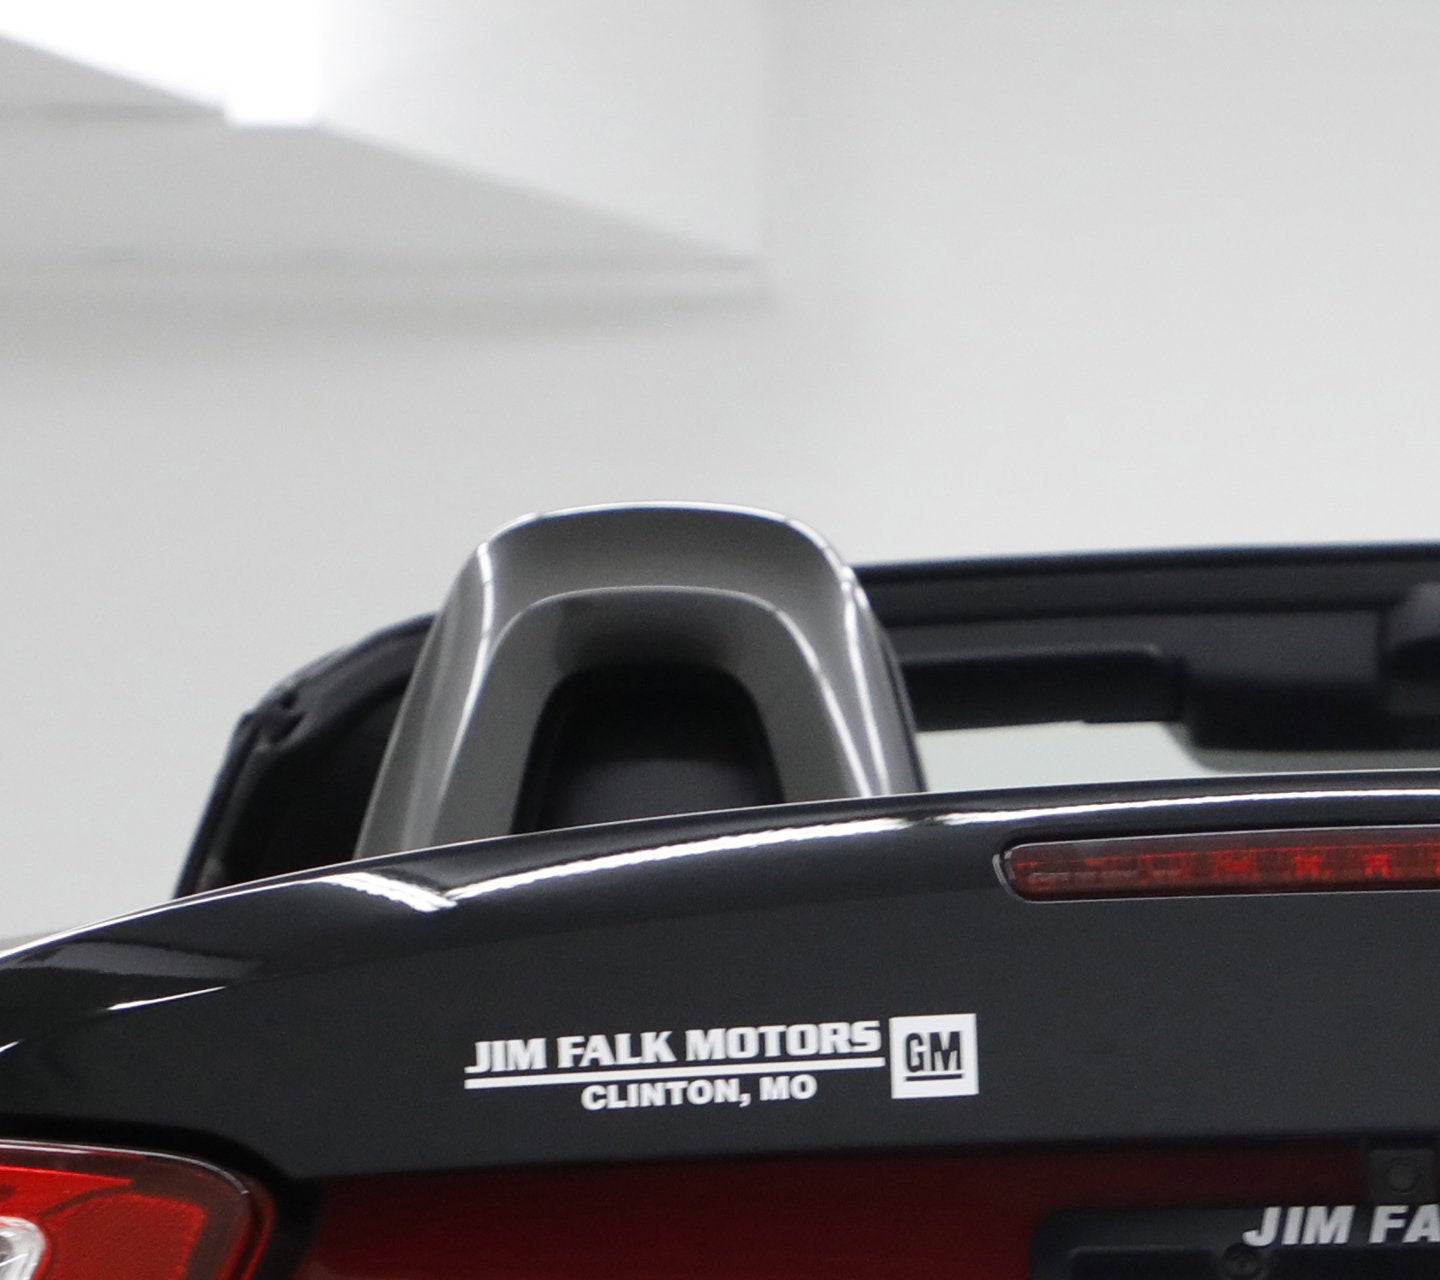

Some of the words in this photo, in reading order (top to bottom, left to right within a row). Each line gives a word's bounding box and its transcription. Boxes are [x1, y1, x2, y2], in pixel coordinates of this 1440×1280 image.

[464, 1037, 548, 1074] JIM
[556, 1030, 676, 1068] FALK
[684, 1020, 883, 1061] MOTORS
[904, 1030, 963, 1073] GM
[580, 1075, 752, 1111] CLINTON,
[758, 1073, 818, 1101] MO
[1243, 1205, 1353, 1247] JIM
